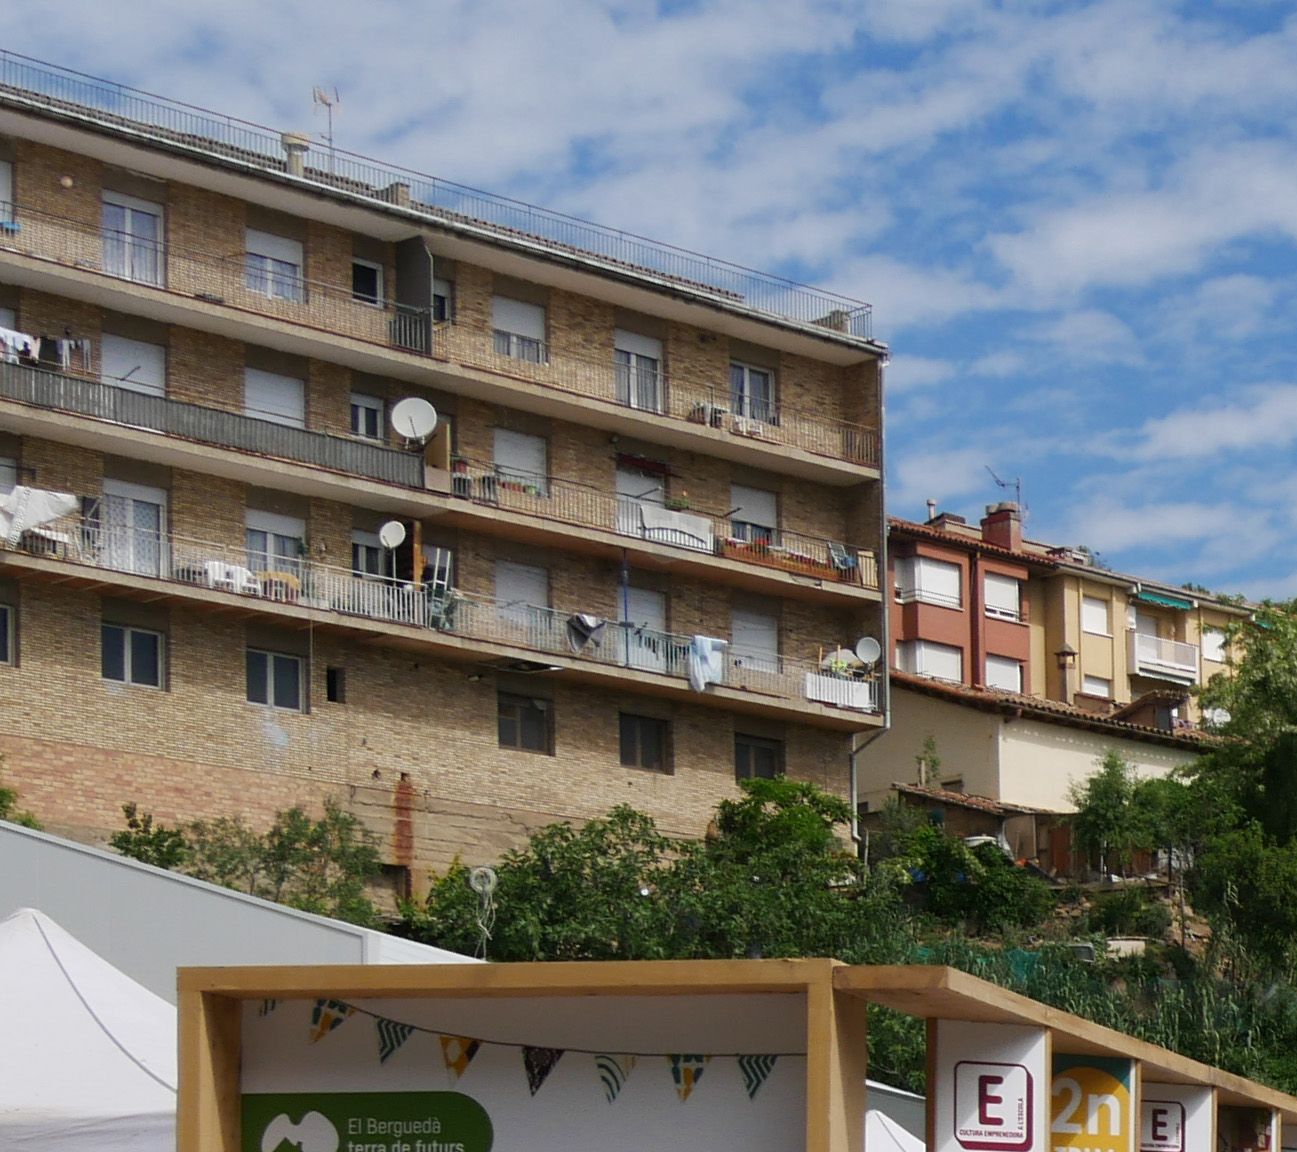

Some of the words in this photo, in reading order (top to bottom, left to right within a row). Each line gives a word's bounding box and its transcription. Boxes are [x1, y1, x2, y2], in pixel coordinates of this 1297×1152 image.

[1050, 1077, 1121, 1136] 2n
[349, 1117, 361, 1135] El
[367, 1117, 441, 1138] Berguedà
